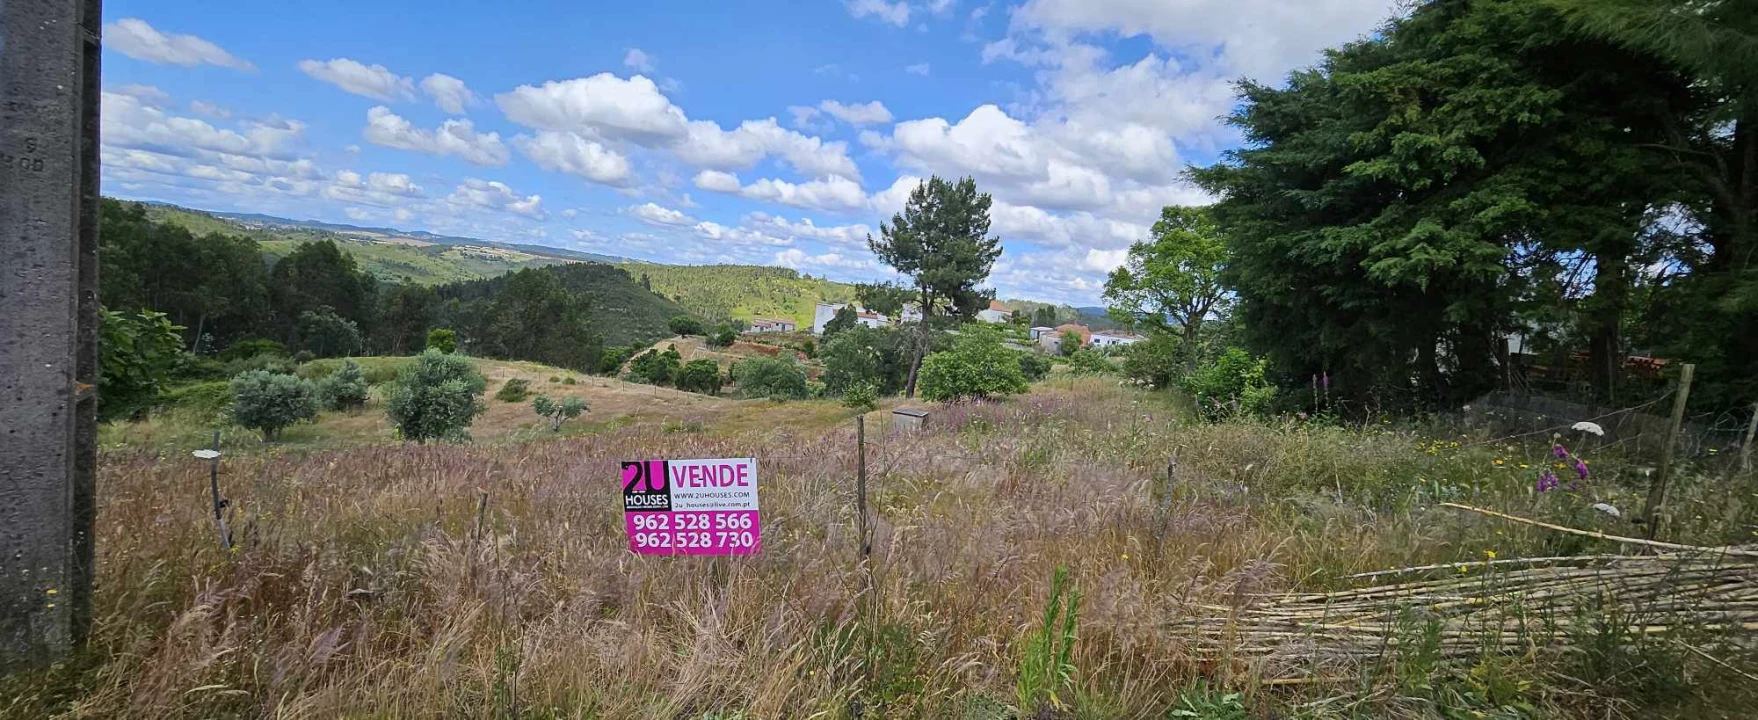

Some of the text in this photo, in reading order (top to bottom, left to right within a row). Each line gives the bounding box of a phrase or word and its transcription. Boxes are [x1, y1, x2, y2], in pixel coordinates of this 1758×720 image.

[622, 460, 670, 493] 2U
[672, 464, 749, 488] VENDE
[625, 494, 669, 506] HOUSES
[633, 513, 752, 530] 962 528 566
[636, 531, 753, 548] 962 528 730
